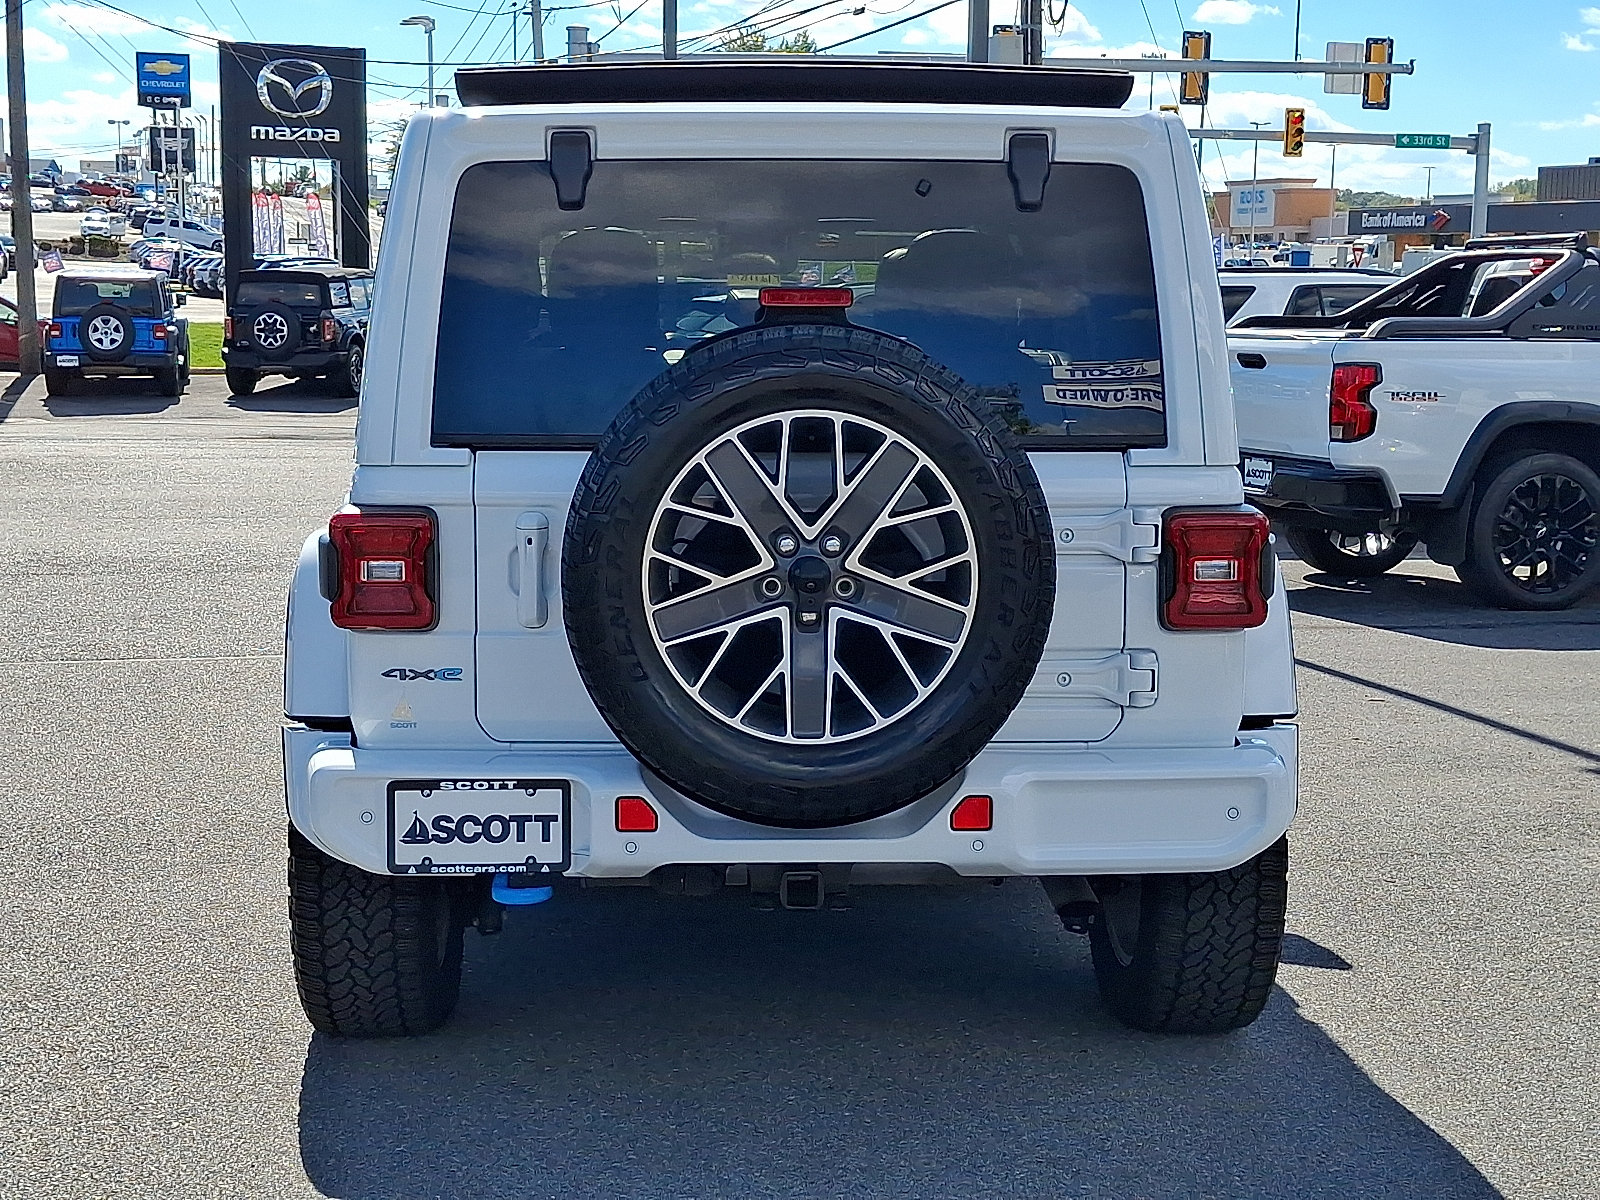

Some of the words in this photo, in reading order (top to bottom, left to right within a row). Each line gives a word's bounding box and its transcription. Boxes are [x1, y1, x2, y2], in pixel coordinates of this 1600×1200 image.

[141, 80, 185, 88] CHEVROLET
[250, 125, 340, 142] mazda
[1413, 135, 1433, 145] 33rd
[1436, 136, 1446, 146] St
[1361, 212, 1382, 228] Bank
[1382, 212, 1392, 228] of
[1391, 212, 1426, 227] America
[1251, 468, 1271, 480] SCOTT
[440, 781, 517, 790] SCOTT
[431, 815, 559, 844] SCOTT
[430, 865, 527, 873] scottcars.com
